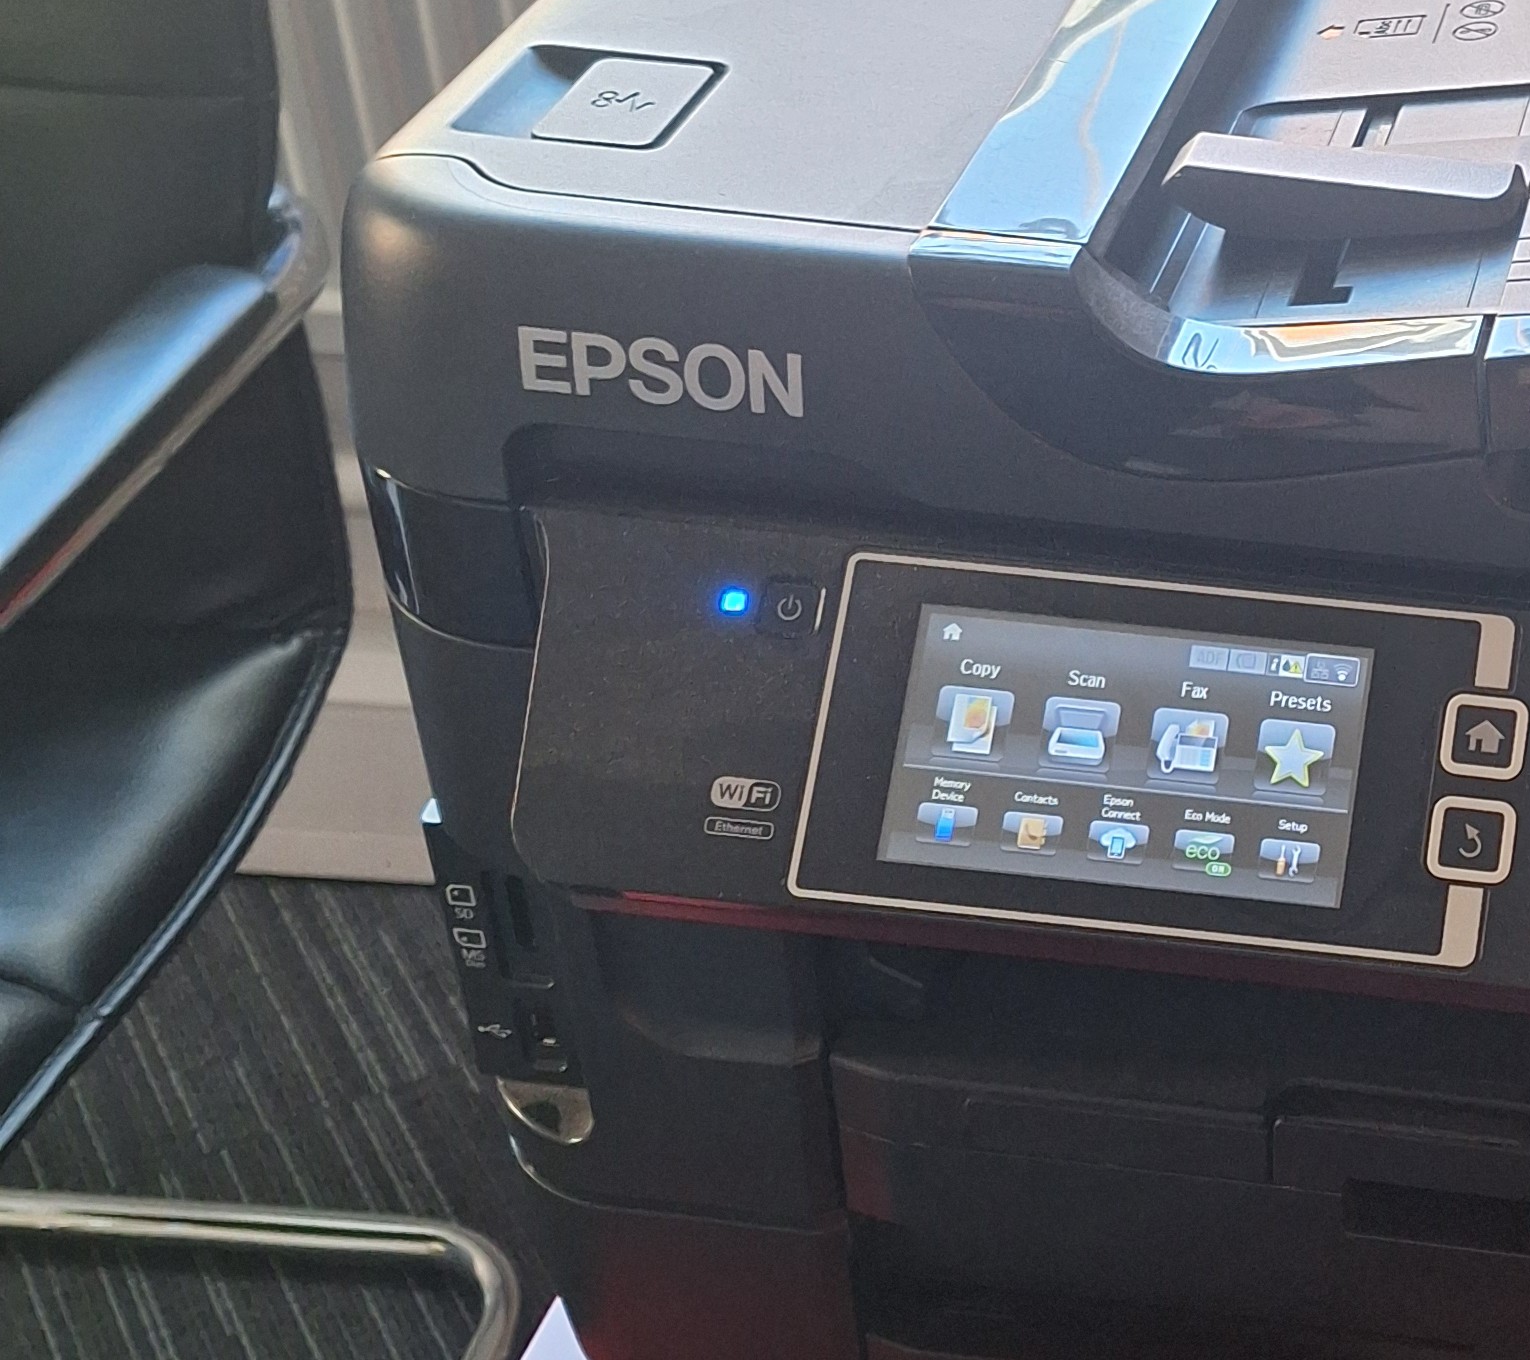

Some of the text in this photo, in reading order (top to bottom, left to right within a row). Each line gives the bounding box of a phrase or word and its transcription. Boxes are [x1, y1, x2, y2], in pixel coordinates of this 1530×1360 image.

[516, 325, 804, 418] EPSON
[959, 658, 1001, 679] Copy
[1067, 670, 1107, 689] Scan
[1180, 681, 1209, 700] Fax
[1269, 690, 1332, 713] Presets
[933, 776, 972, 792] Memory
[931, 789, 965, 803] Device
[1014, 791, 1059, 806] Contacts
[1102, 793, 1134, 808] Epson
[1101, 807, 1142, 821] Connect
[1184, 809, 1231, 825] Eco Mode
[714, 820, 764, 836] Ethernet
[1277, 819, 1308, 834] Setup
[1185, 844, 1220, 861] eco
[454, 907, 474, 919] SD
